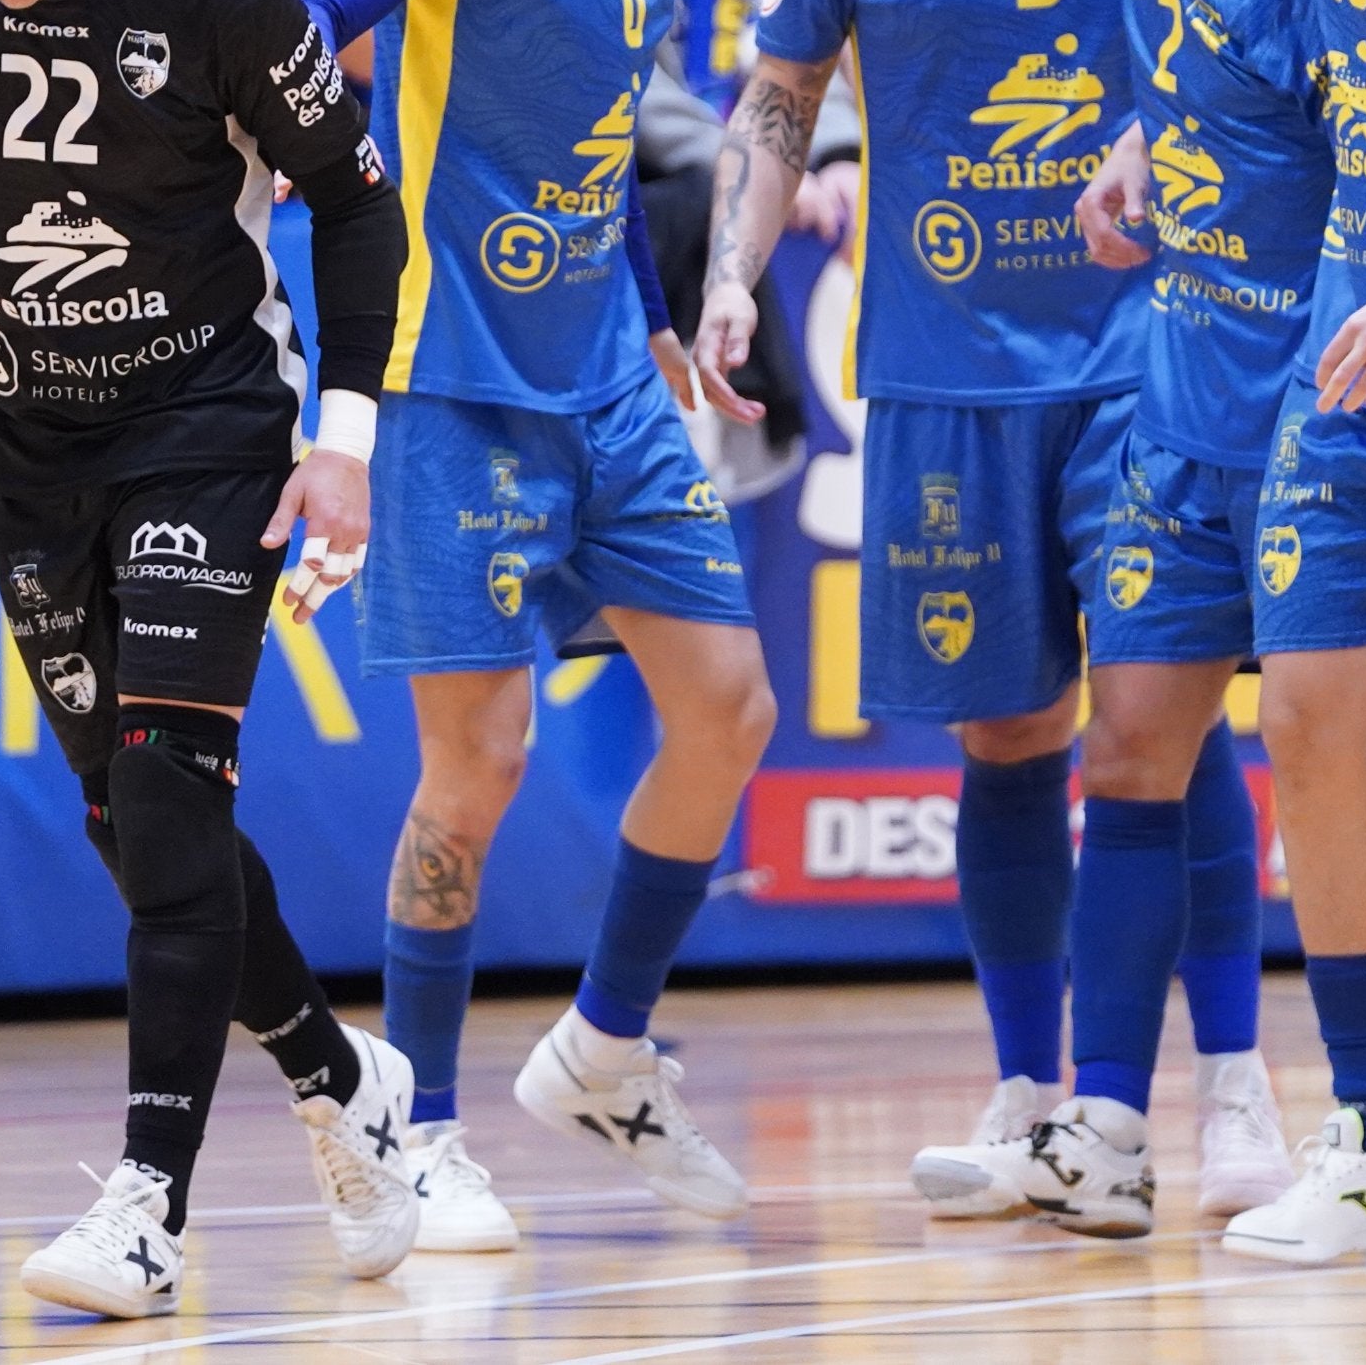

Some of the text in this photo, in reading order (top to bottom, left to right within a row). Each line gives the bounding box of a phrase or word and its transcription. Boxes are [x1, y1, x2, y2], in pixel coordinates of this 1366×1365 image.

[2, 15, 90, 39] Kromex
[268, 21, 317, 86] Krom
[0, 52, 100, 166] 22
[31, 324, 216, 379] SERVIGROUP
[32, 385, 119, 403] HOTELES
[123, 616, 199, 640] Kromex
[803, 796, 959, 882] DES
[129, 1091, 193, 1112] omex
